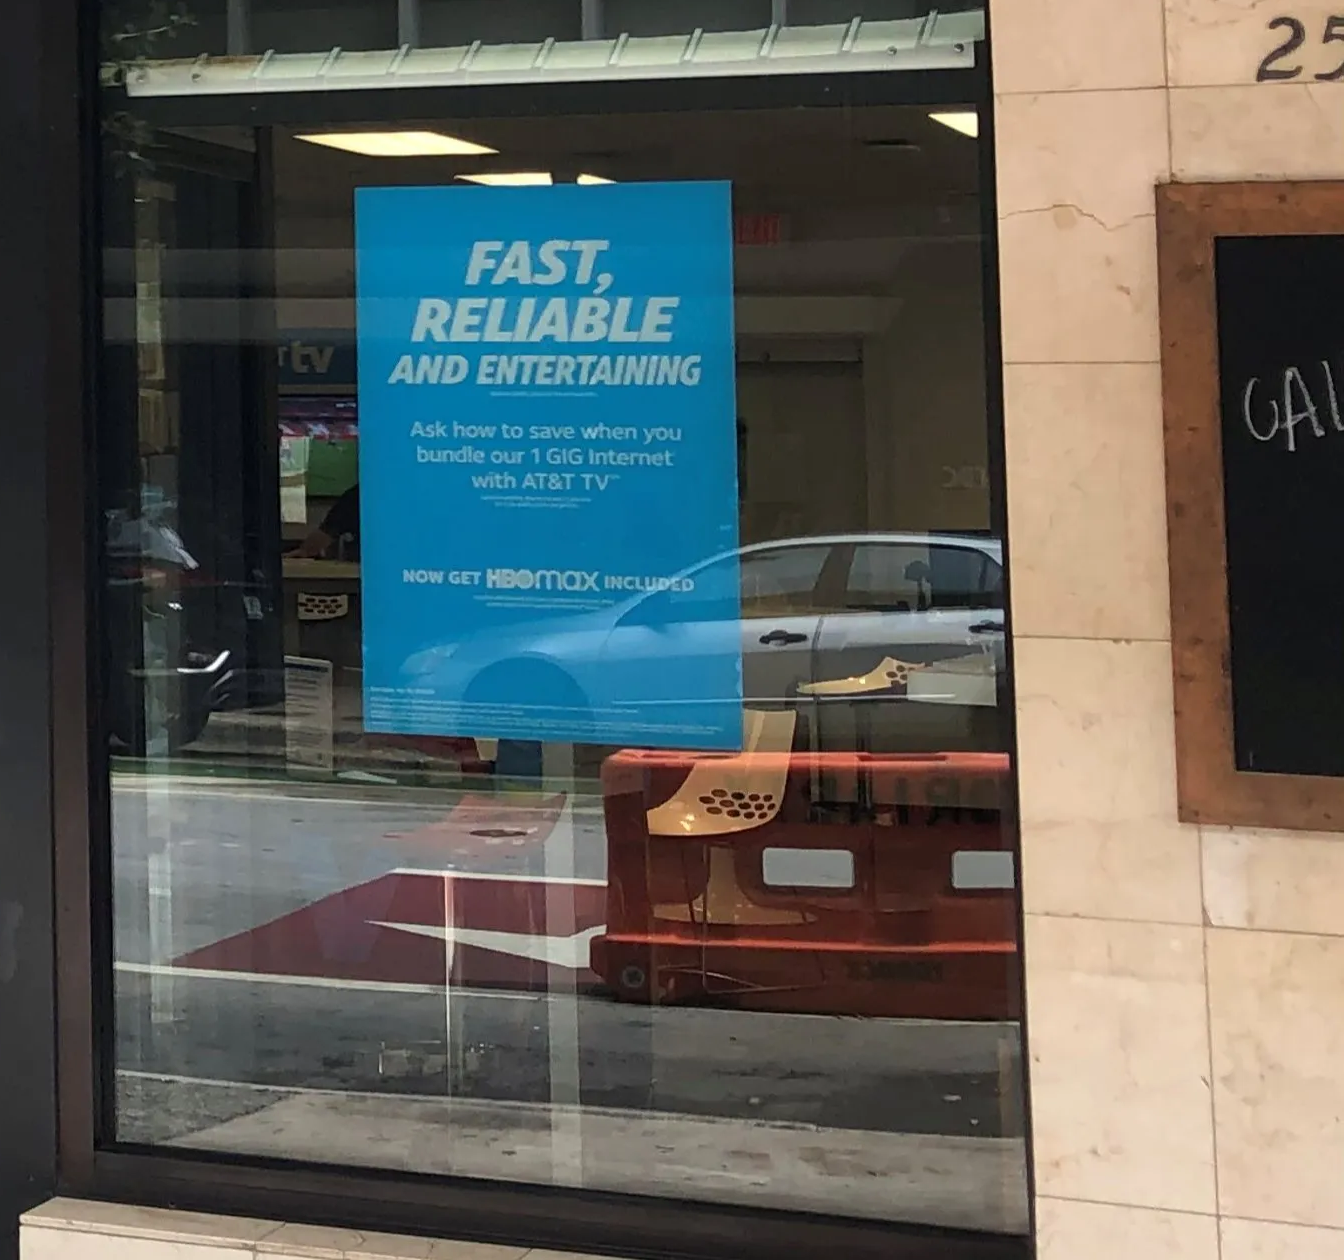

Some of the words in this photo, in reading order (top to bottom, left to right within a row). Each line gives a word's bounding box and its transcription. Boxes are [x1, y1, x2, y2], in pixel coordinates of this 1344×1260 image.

[465, 239, 613, 295] FAST,
[411, 296, 680, 343] RELIABLE
[388, 355, 469, 385] AND
[476, 355, 702, 386] ENTERTAINING
[411, 421, 447, 439] Ask
[453, 421, 497, 439] how
[502, 423, 524, 439] to
[529, 426, 575, 440] save
[581, 422, 638, 441] when
[642, 427, 682, 445] you
[417, 446, 485, 465] bundle
[490, 449, 525, 465] our
[532, 448, 540, 465] 1
[546, 448, 584, 466] GIG
[589, 449, 674, 467] Internet
[472, 471, 516, 490] with
[522, 473, 574, 490] AT&T
[402, 569, 444, 585] NOW
[448, 571, 481, 585] GET
[604, 576, 695, 592] INCLUDED
